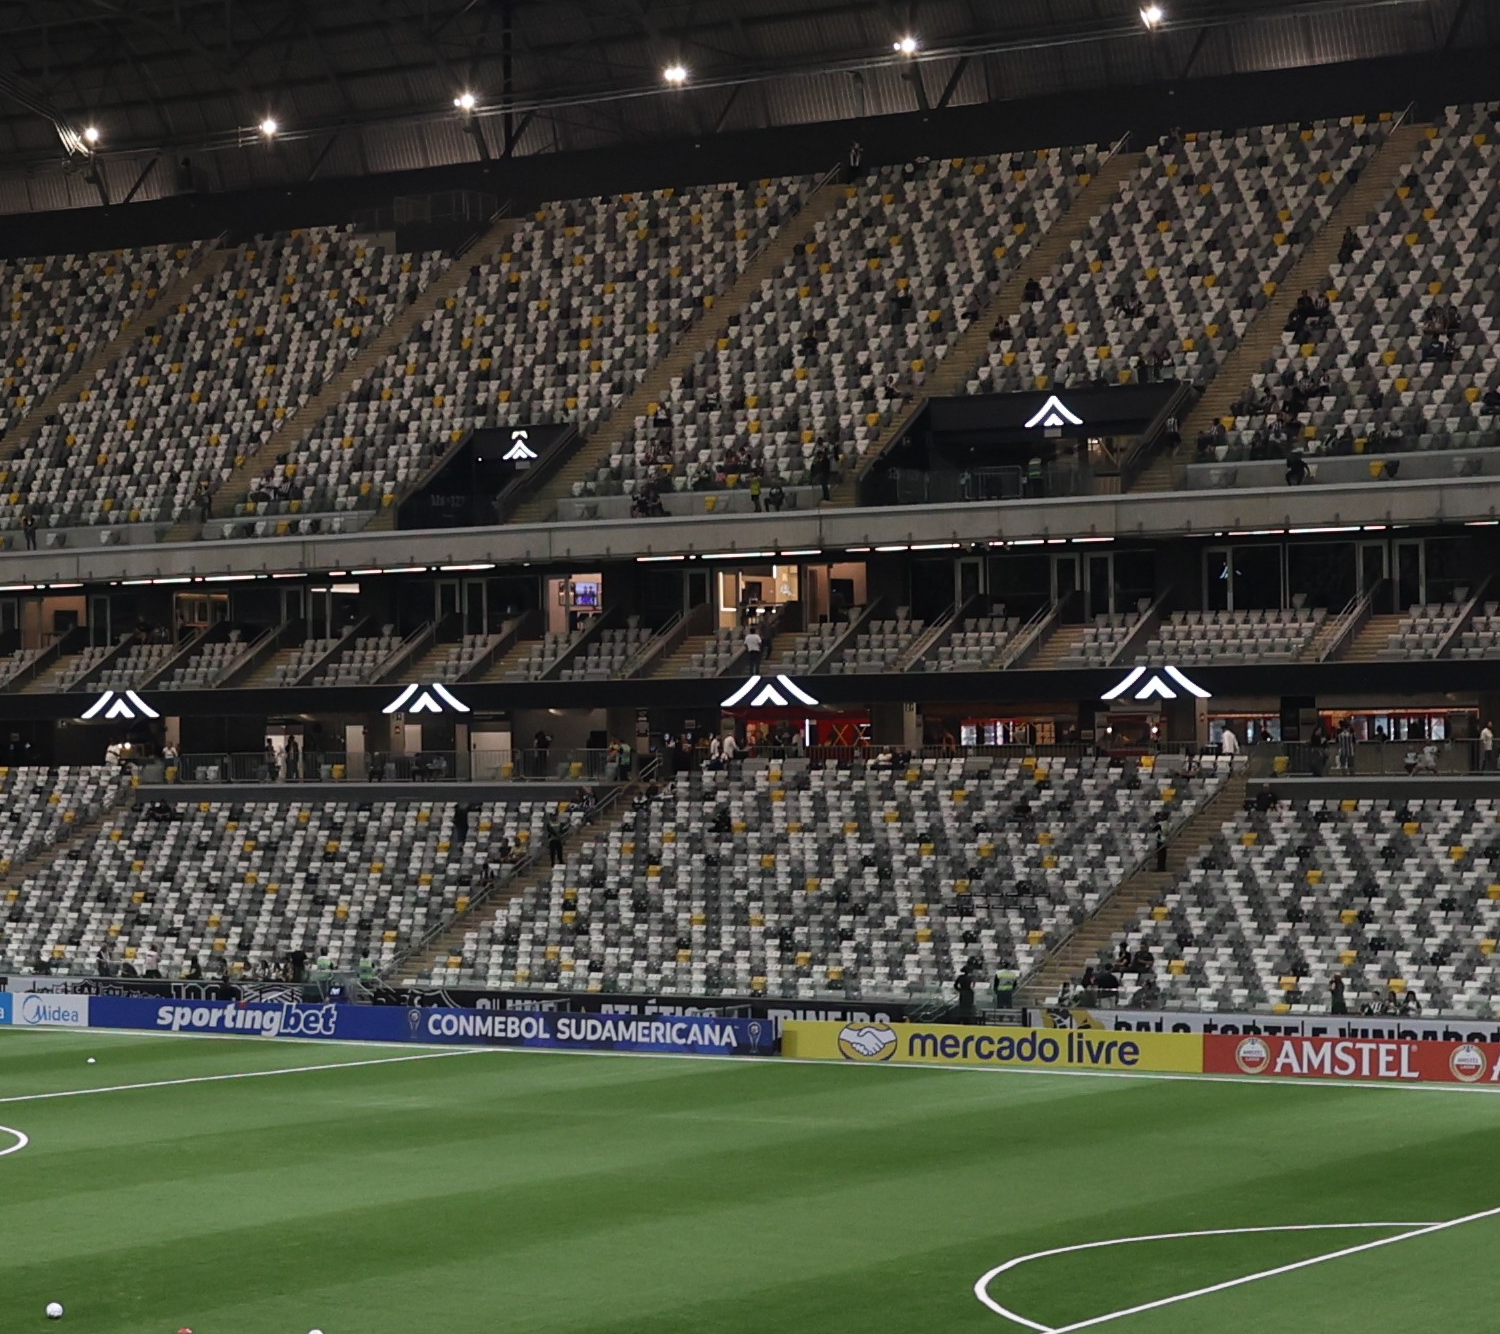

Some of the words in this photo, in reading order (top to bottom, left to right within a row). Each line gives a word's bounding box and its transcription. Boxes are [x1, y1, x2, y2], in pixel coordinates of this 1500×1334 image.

[34, 997, 79, 1023] Midea
[157, 1001, 337, 1036] sportingbet
[428, 1014, 550, 1039] CONMEBOL
[557, 1018, 738, 1047] SUDAMERICANA
[908, 1030, 1060, 1062] mercado
[1067, 1030, 1140, 1065] livre
[1274, 1039, 1419, 1078] AMSTEL
